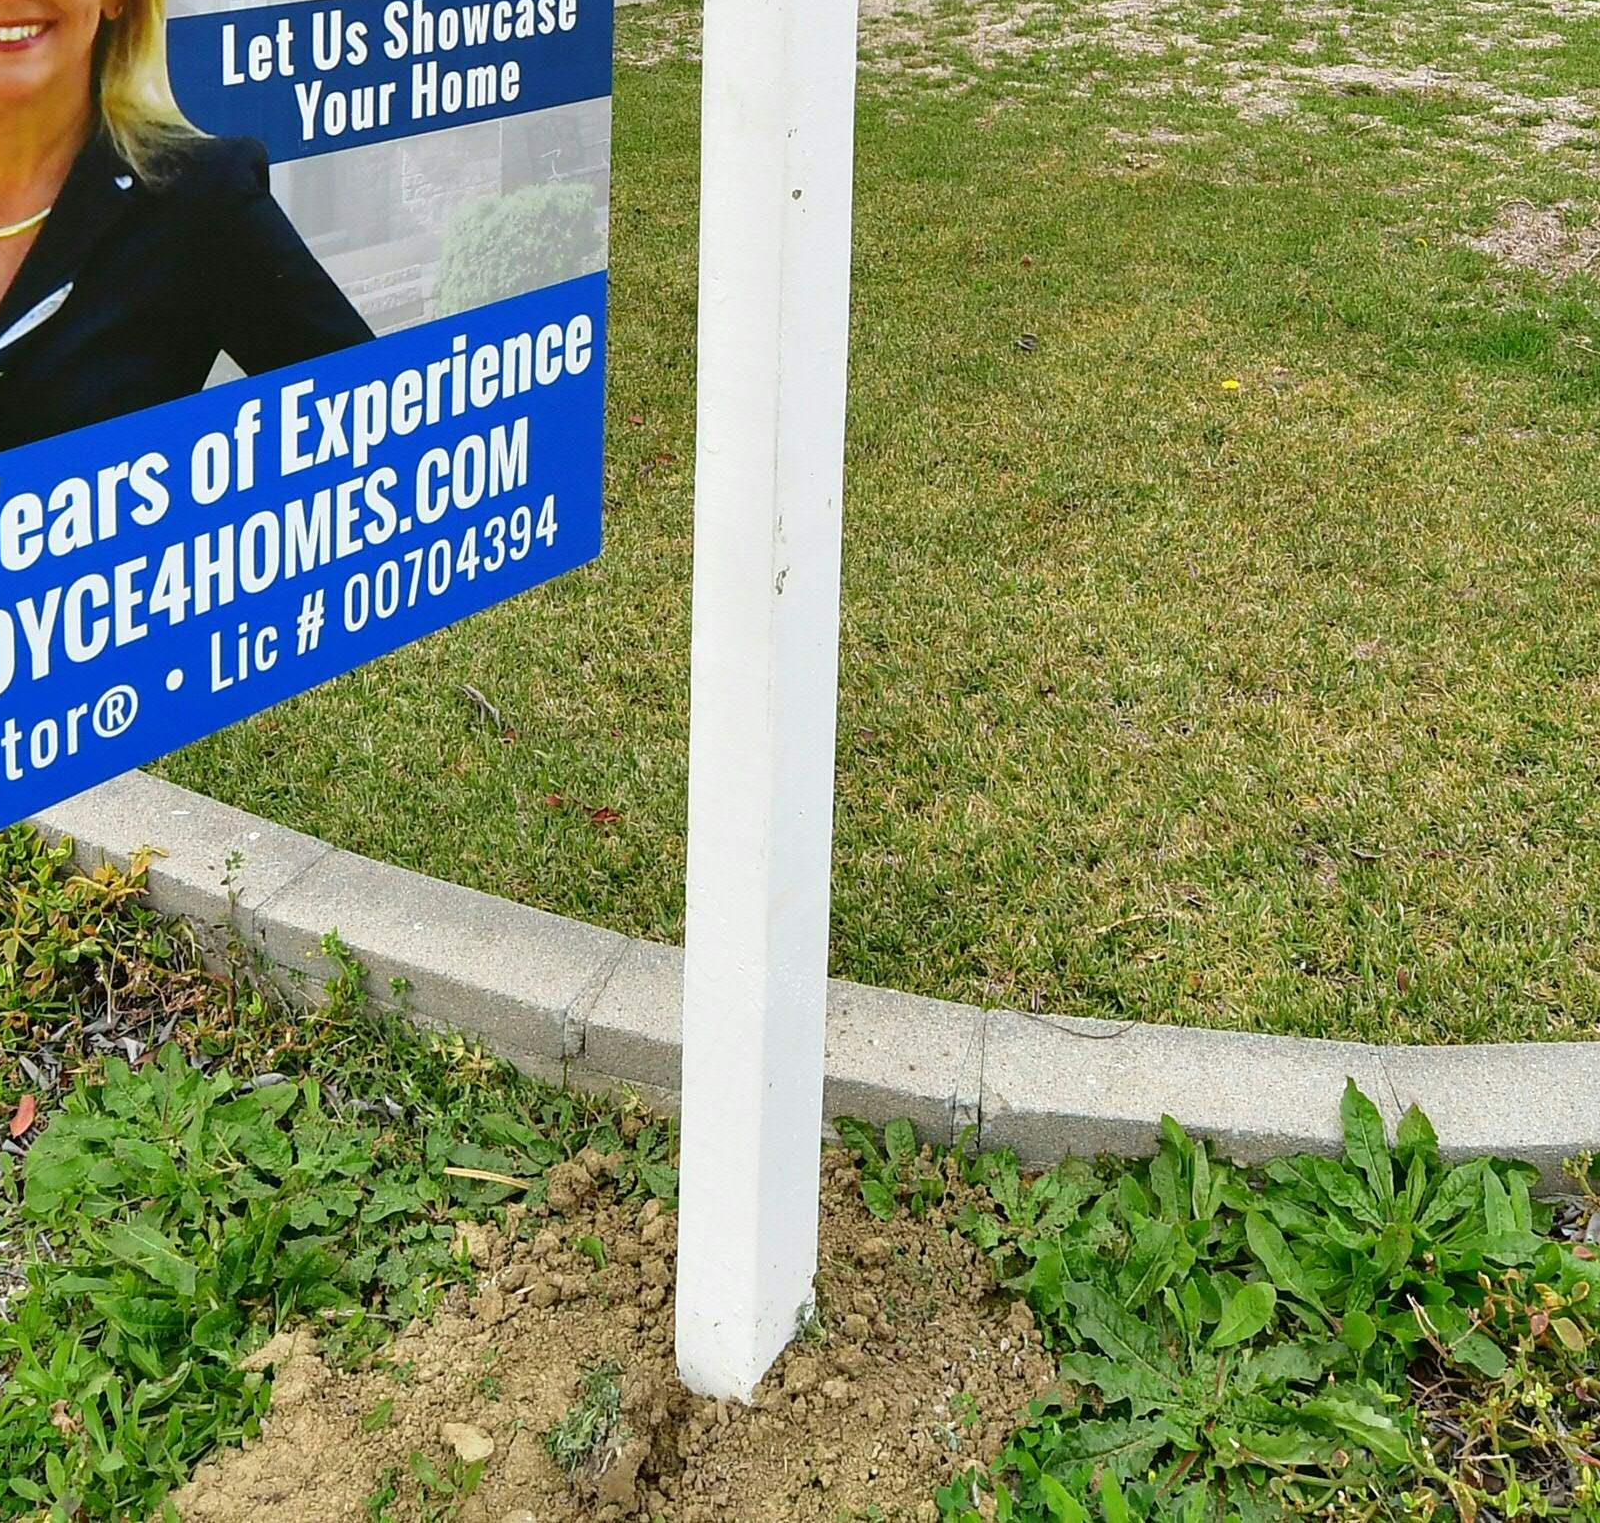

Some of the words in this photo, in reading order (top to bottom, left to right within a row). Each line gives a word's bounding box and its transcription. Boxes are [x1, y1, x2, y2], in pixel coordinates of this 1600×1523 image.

[222, 18, 295, 86] Let
[312, 10, 369, 71] Us
[294, 79, 396, 141] Your
[411, 60, 521, 119] Home
[191, 398, 261, 505] of
[281, 313, 593, 469] Experience
[211, 622, 278, 694] Lic
[296, 588, 325, 656] #
[343, 493, 558, 634] 00704394
